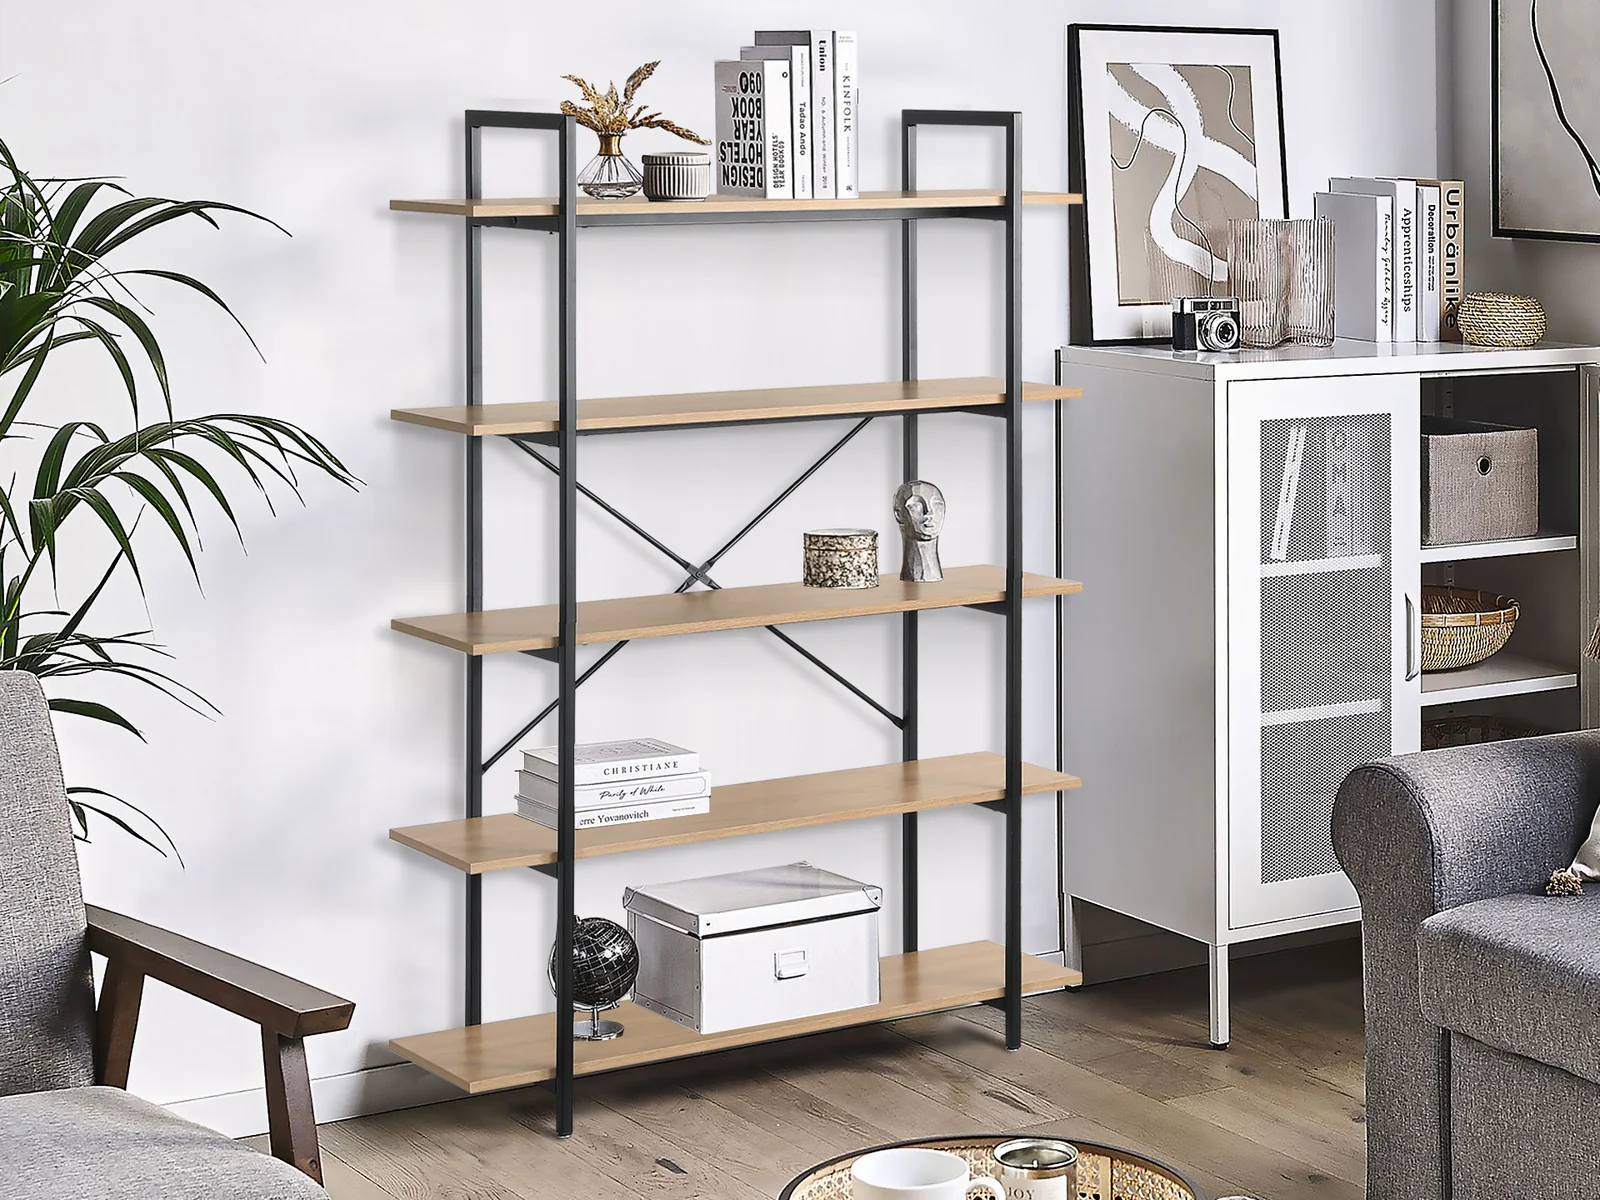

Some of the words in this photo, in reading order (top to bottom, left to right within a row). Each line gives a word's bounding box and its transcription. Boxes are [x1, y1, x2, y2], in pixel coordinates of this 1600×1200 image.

[819, 40, 827, 72] Union
[731, 97, 762, 119] BOOK
[843, 75, 852, 132] KINFOLK
[799, 102, 807, 130] Tadao
[733, 120, 763, 141] YEAR
[799, 131, 807, 156] Ando
[722, 165, 764, 188] DESIGN
[1428, 204, 1436, 254] Decoration
[1401, 208, 1413, 313] Apprenticeships
[1445, 189, 1460, 328] Urbänlike
[603, 761, 679, 776] CHRISTIANE
[599, 789, 627, 800] Purity
[630, 787, 639, 796] of
[640, 784, 666, 796] White
[579, 817, 596, 826] erre
[597, 810, 649, 824] Yovanovitch
[1007, 1187, 1035, 1200] JOY
